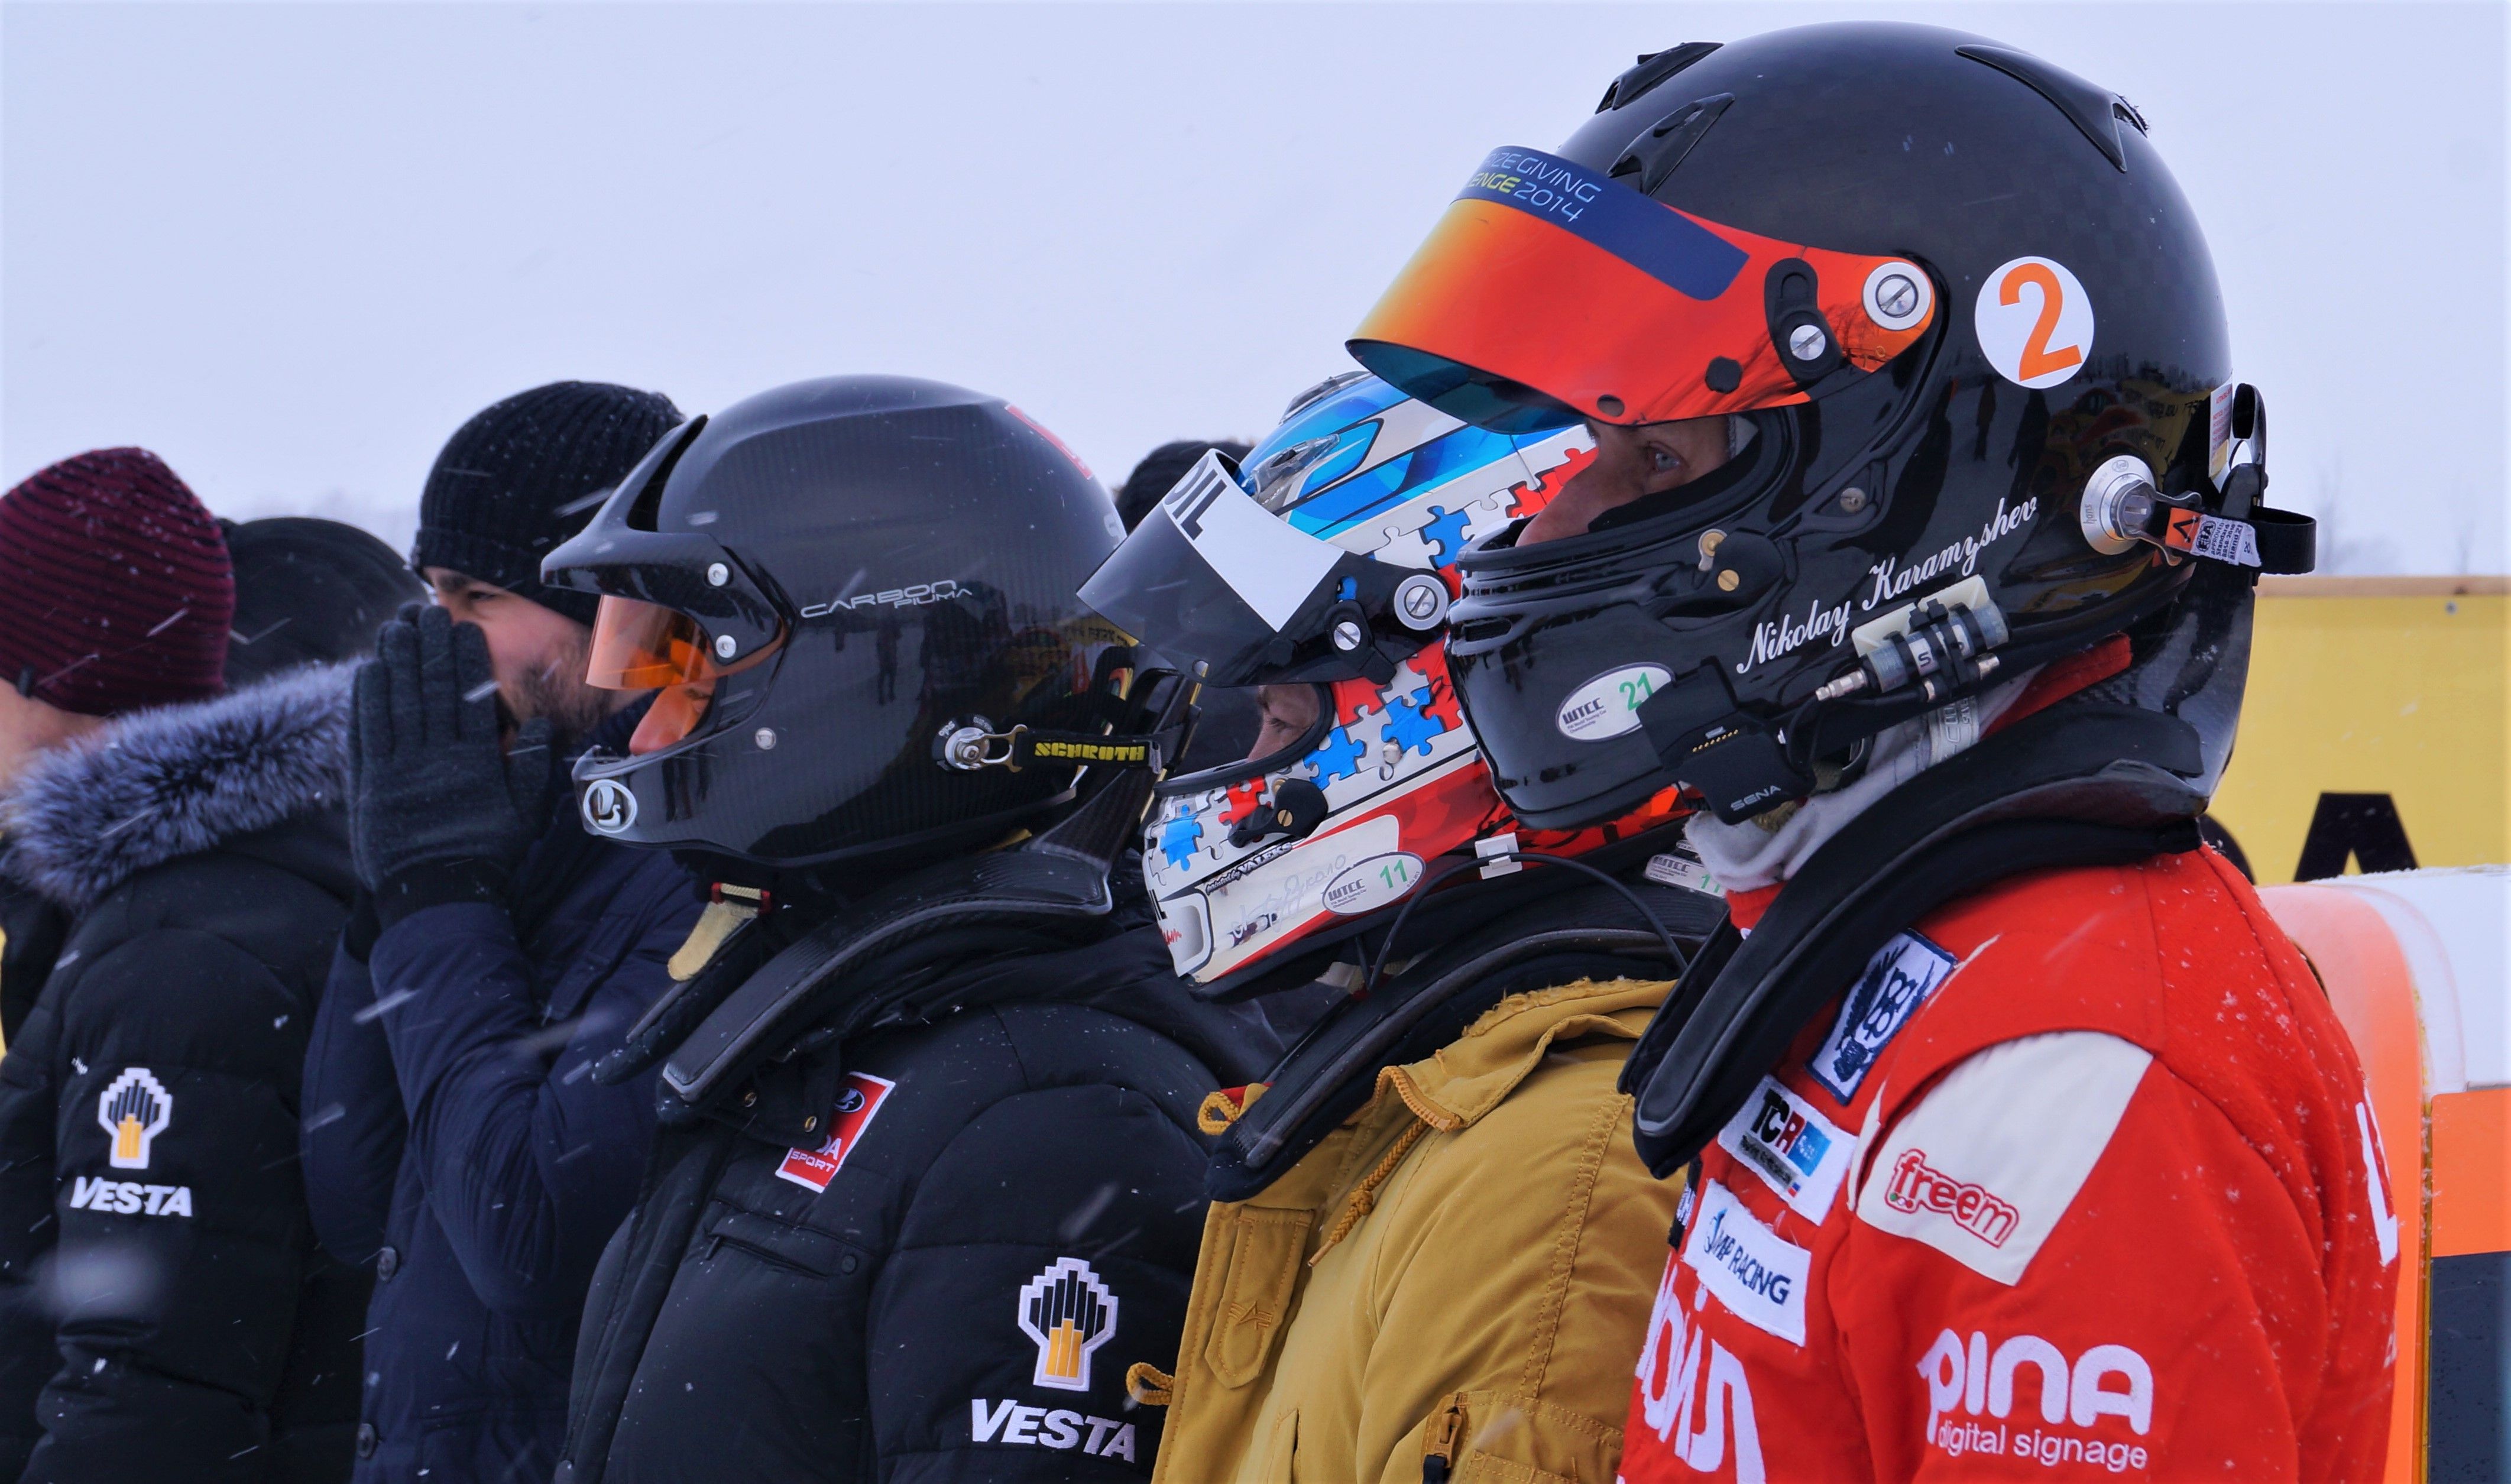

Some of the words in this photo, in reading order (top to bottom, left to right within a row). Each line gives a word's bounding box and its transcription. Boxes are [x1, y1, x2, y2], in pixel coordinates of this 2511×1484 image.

[1513, 181, 1584, 223] 2014
[1516, 157, 1602, 203] GIVING
[1999, 263, 2082, 382] 2
[2198, 523, 2215, 550] FIA
[800, 579, 957, 618] CARBON
[1736, 600, 1852, 673] Nikolay
[1862, 497, 2037, 611] Karamyshev
[1562, 697, 1605, 725] WTCC
[1619, 671, 1654, 711] 21
[1034, 741, 1145, 761] SCHROTH
[1730, 783, 1781, 812] SENA
[1327, 878, 1366, 902] WTCC
[1379, 858, 1408, 889] 11
[1750, 1088, 1807, 1155] TCR
[791, 1150, 835, 1172] SPORT
[70, 1176, 193, 1217] VESTA
[1892, 1153, 2015, 1243] freem
[1728, 1245, 1793, 1305] RACING
[971, 1398, 1136, 1464] VESTA
[1937, 1420, 2006, 1457] digital
[2013, 1428, 2147, 1473] signage
